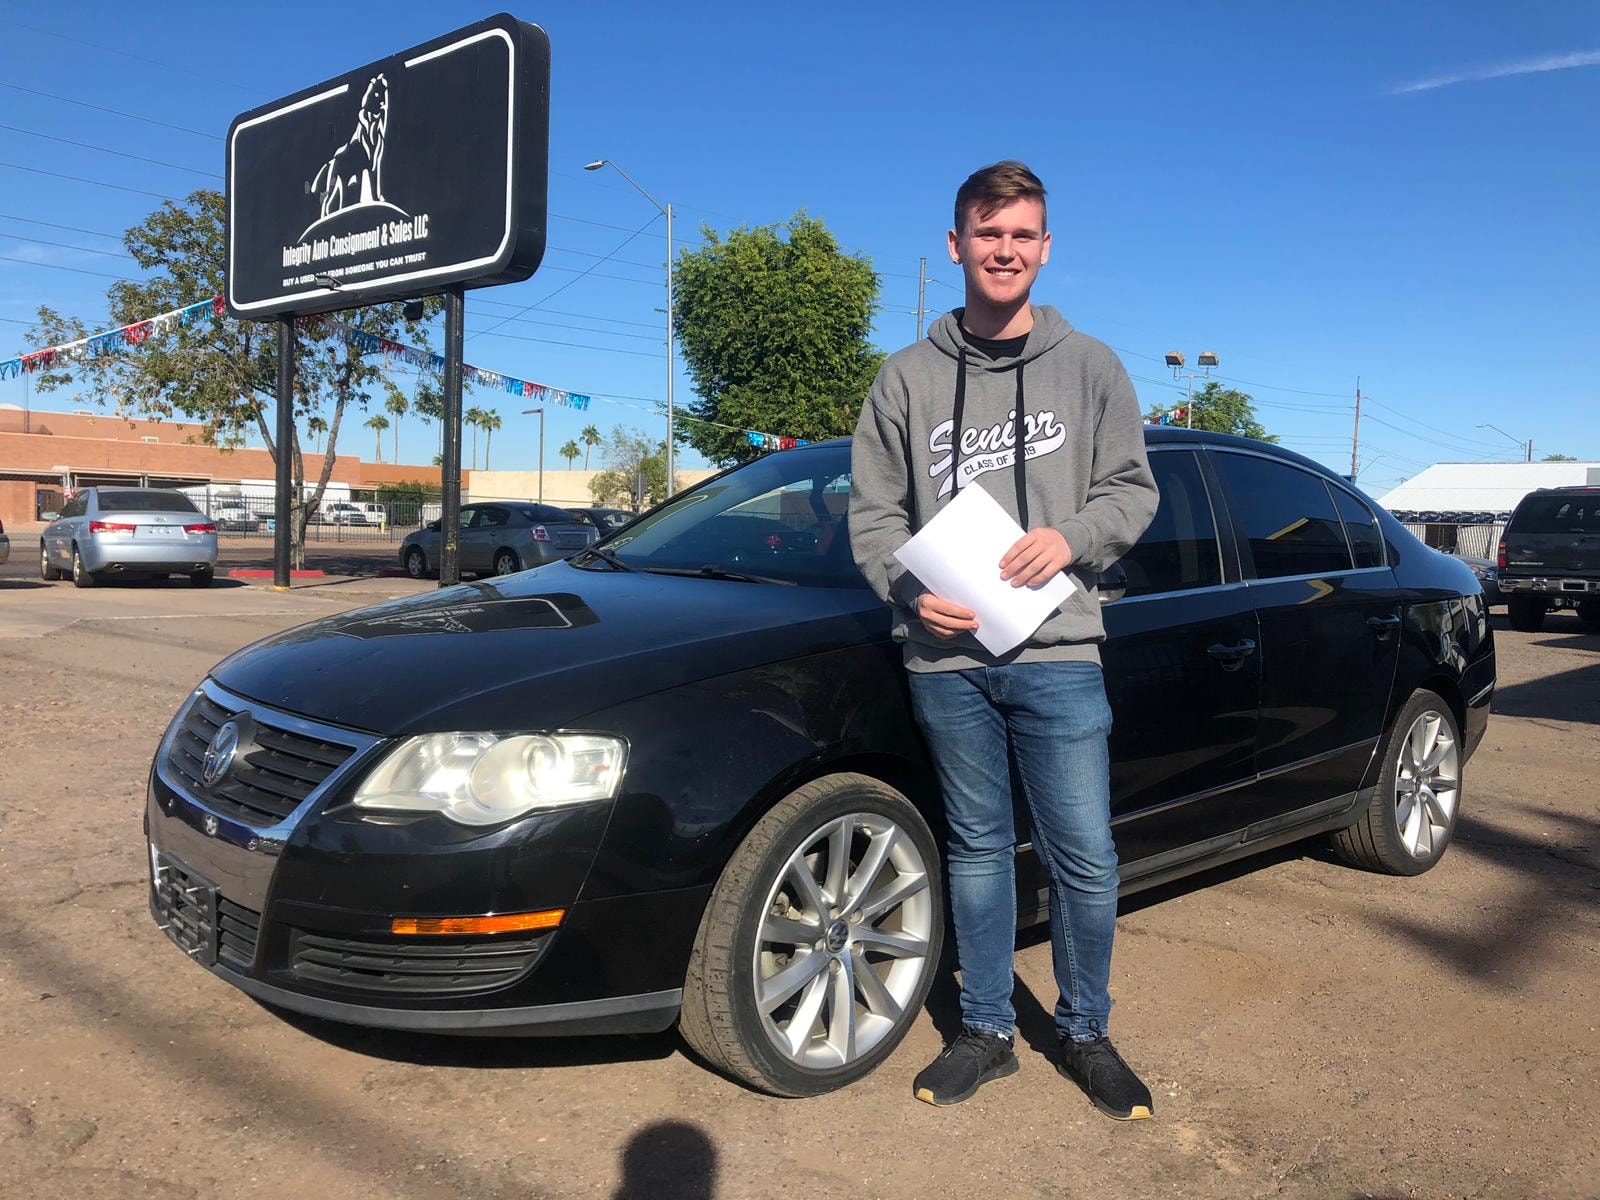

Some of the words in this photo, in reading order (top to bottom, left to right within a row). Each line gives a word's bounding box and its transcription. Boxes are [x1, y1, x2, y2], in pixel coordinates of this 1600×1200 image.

[282, 243, 312, 267] Integrity
[312, 239, 329, 261] Auto
[330, 226, 380, 257] Consignment
[381, 223, 388, 246] &
[389, 219, 413, 245] Sales
[414, 213, 429, 239] LLC
[282, 278, 295, 287] BUY
[295, 277, 300, 285] A
[300, 274, 315, 284] USED
[328, 268, 344, 277] FROM
[345, 262, 375, 275] SOMEONE
[375, 259, 389, 269] YOU
[389, 257, 403, 266] CAN
[404, 252, 427, 264] TRUST
[928, 409, 1056, 478] Senior
[963, 460, 995, 475] CLASS
[996, 454, 1009, 466] OF
